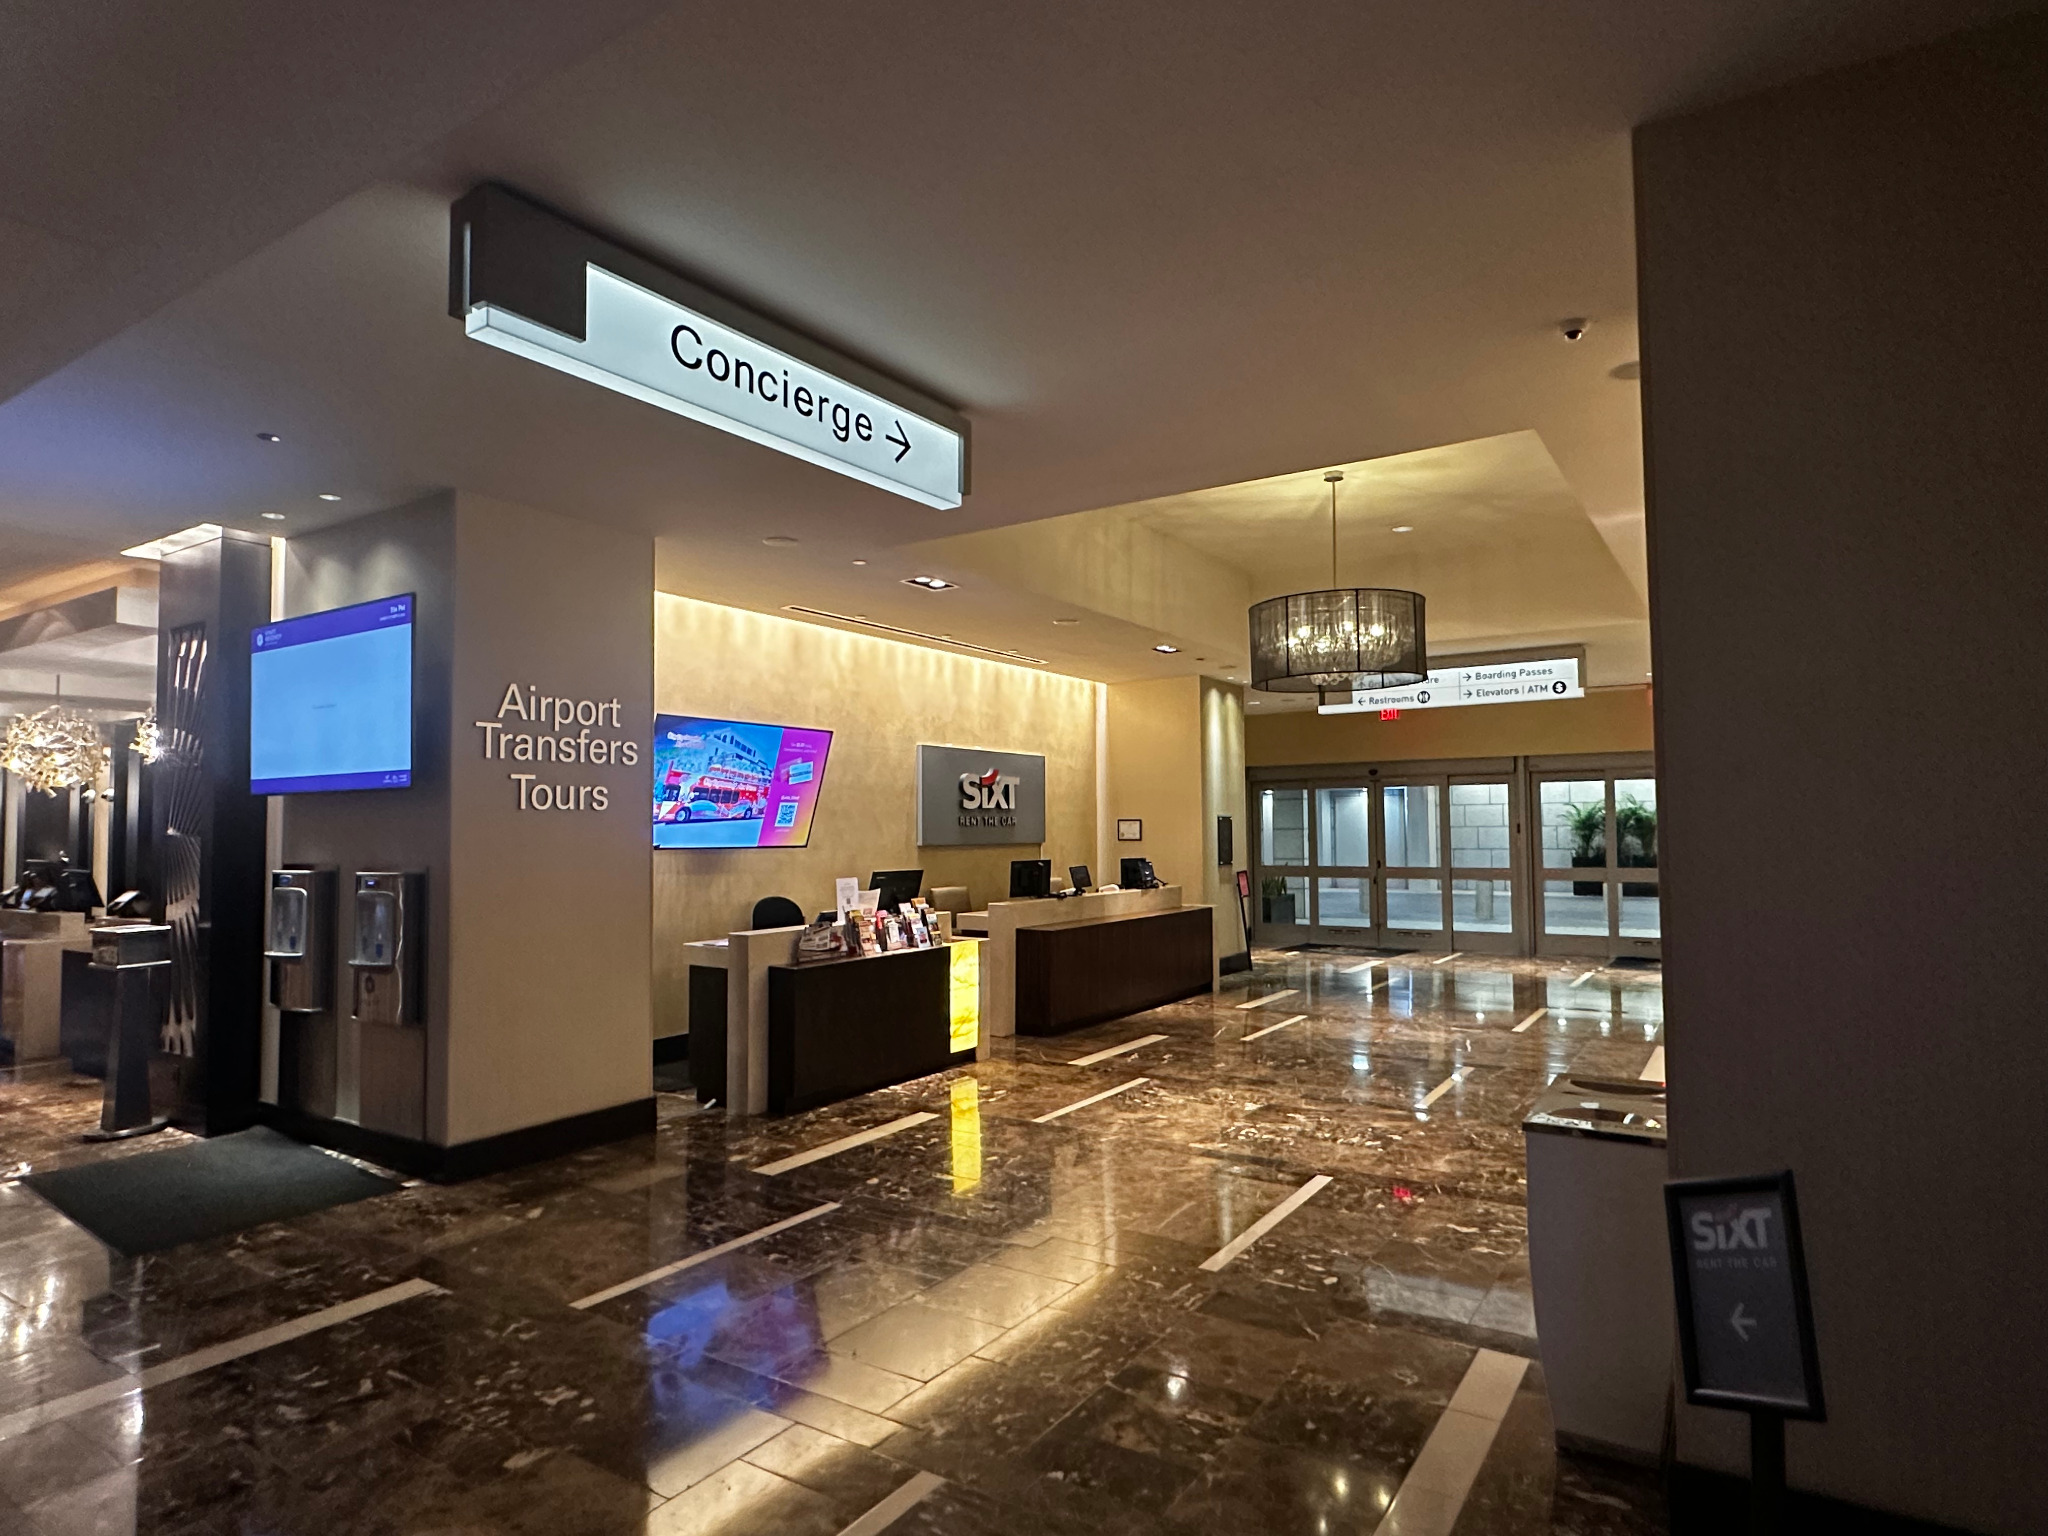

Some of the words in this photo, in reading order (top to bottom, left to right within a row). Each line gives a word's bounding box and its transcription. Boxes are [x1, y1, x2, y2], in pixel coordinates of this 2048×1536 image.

[670, 324, 873, 442] Concierge
[1475, 670, 1517, 680] Boarding
[1519, 668, 1553, 677] Passes
[1476, 687, 1520, 698] Elevators
[1527, 684, 1548, 694] ATM
[1368, 695, 1415, 705] Restrooms
[497, 683, 621, 732] Airport
[475, 721, 638, 766] Transfers
[510, 773, 609, 811] Tours
[959, 816, 980, 827] RENT
[983, 816, 998, 827] THE
[1001, 816, 1017, 827] CAR
[1728, 1257, 1749, 1269] THE
